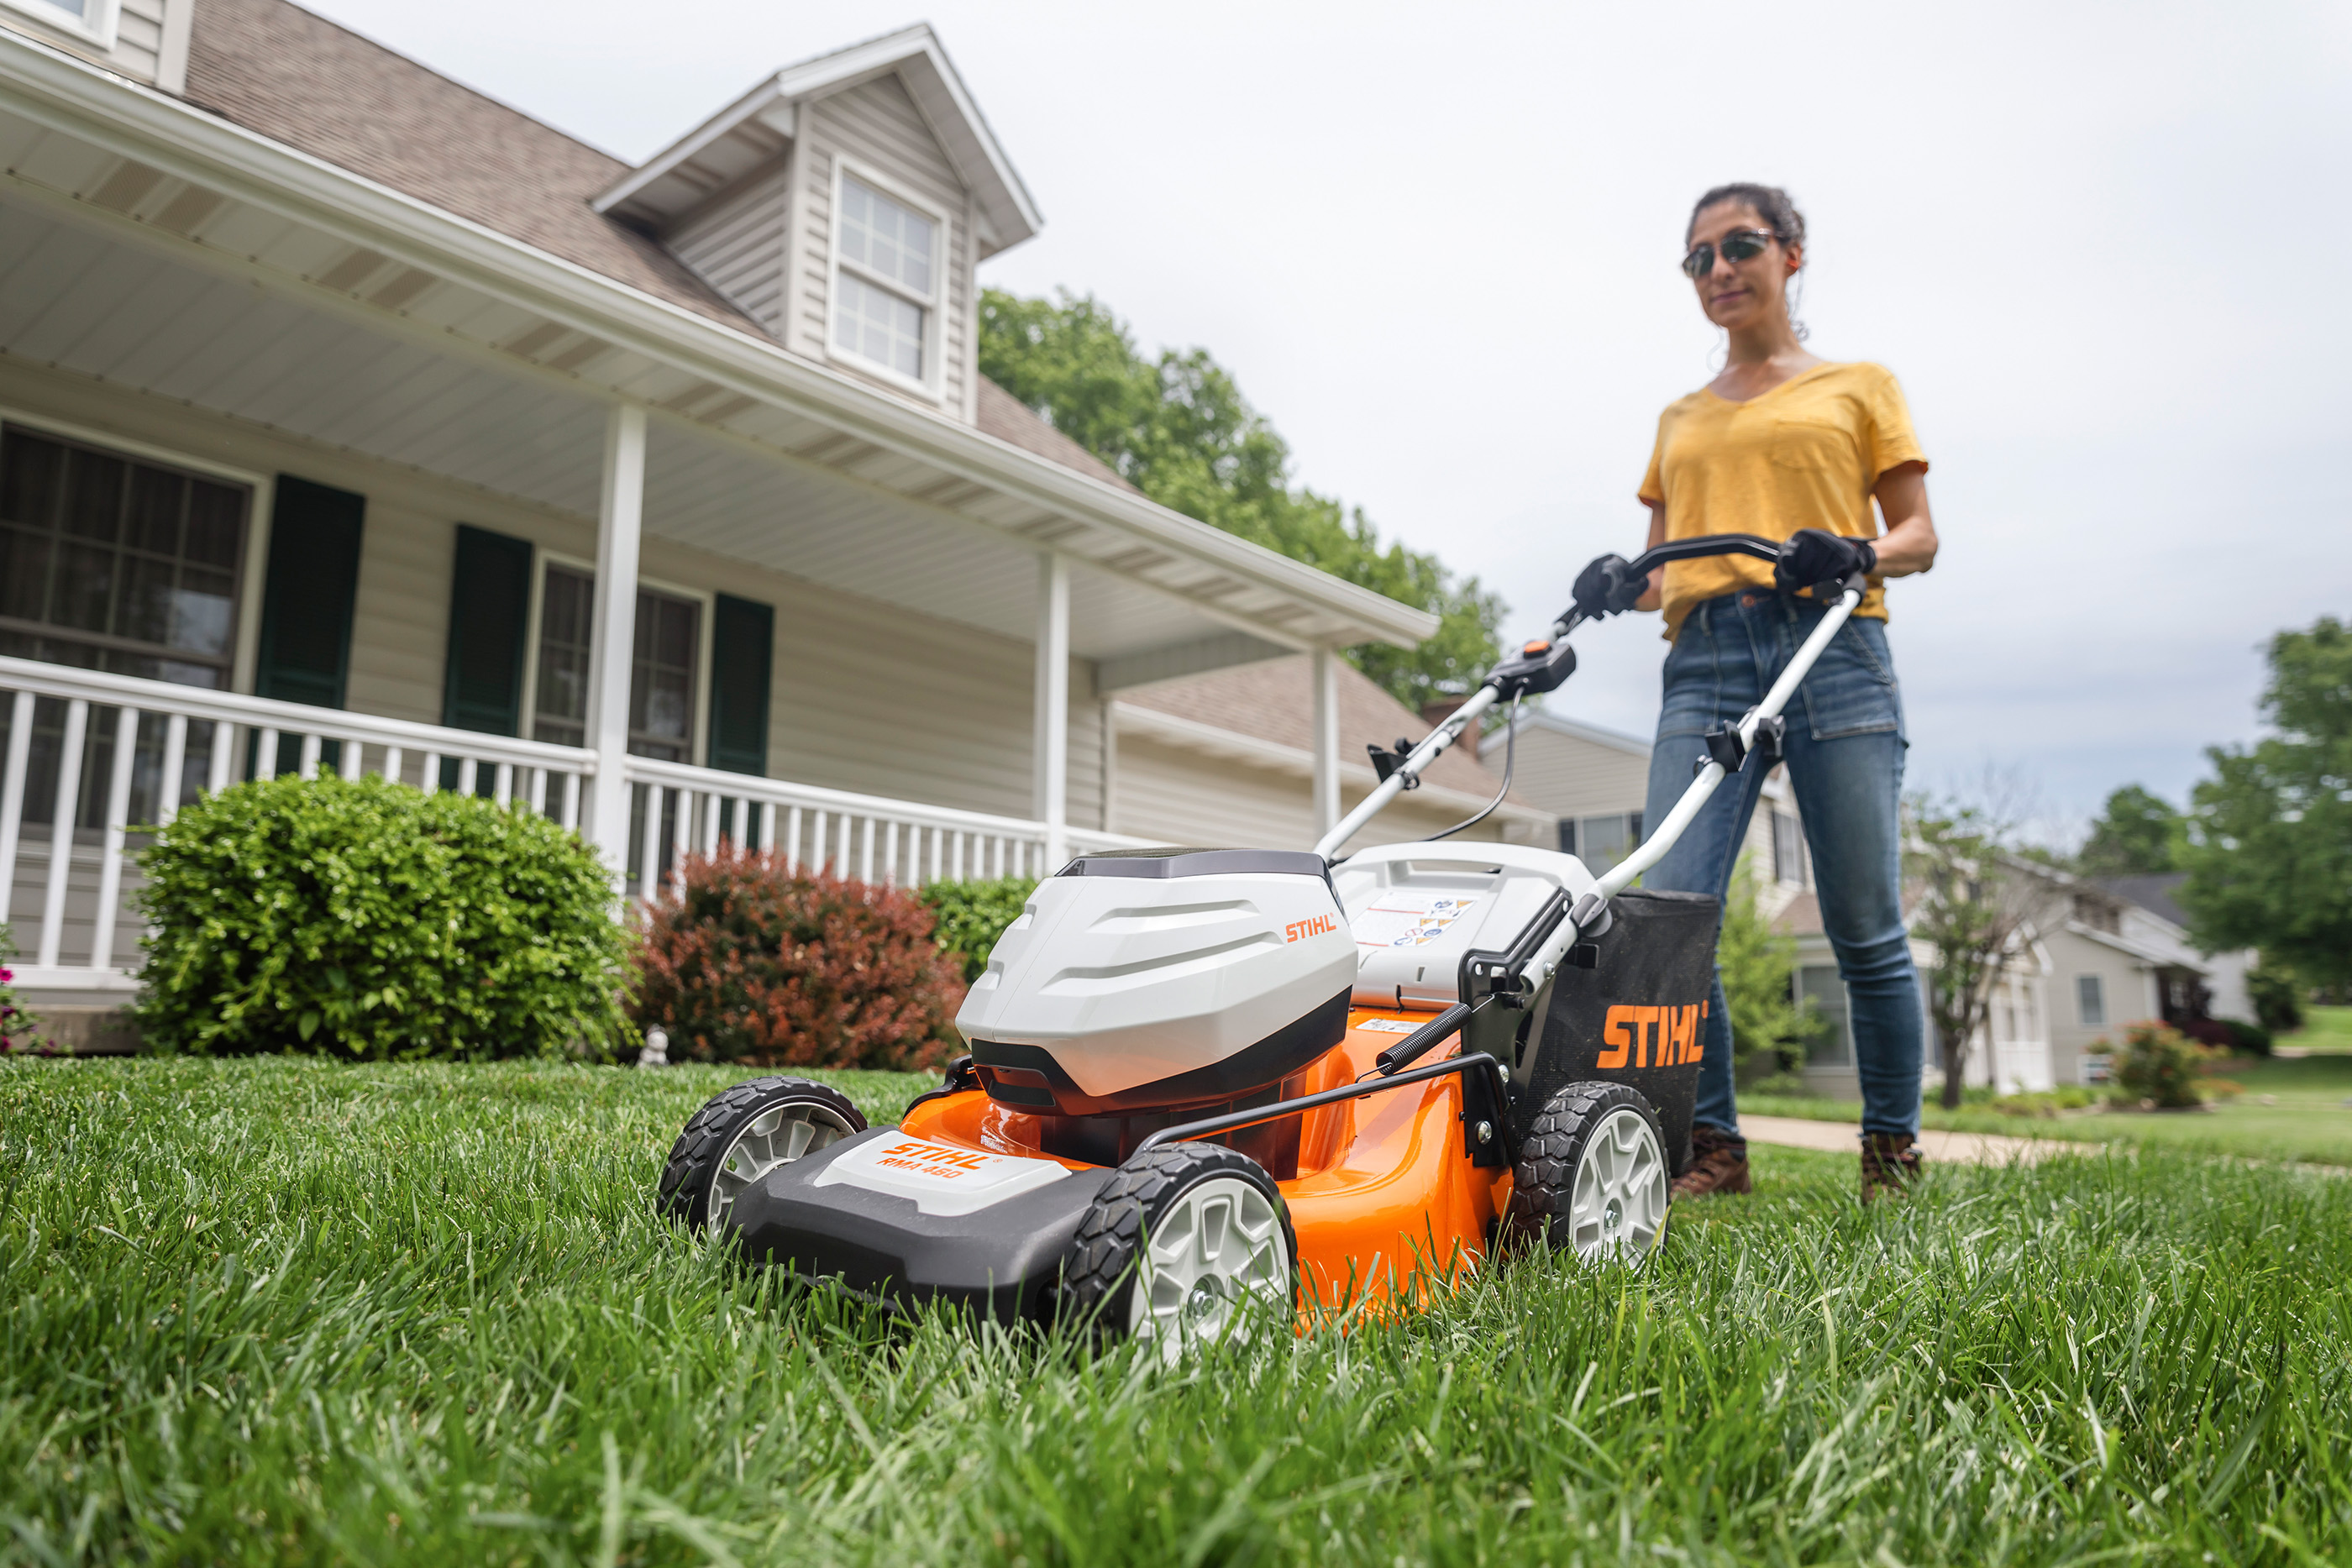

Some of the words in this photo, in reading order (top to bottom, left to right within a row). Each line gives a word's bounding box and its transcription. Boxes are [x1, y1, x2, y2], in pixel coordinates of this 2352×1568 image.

[1285, 915, 1336, 943] STIHL
[1596, 1004, 1704, 1069] STIHL
[875, 1157, 922, 1171] RMA
[921, 1166, 964, 1179] 460
[880, 1142, 990, 1170] STIHL
